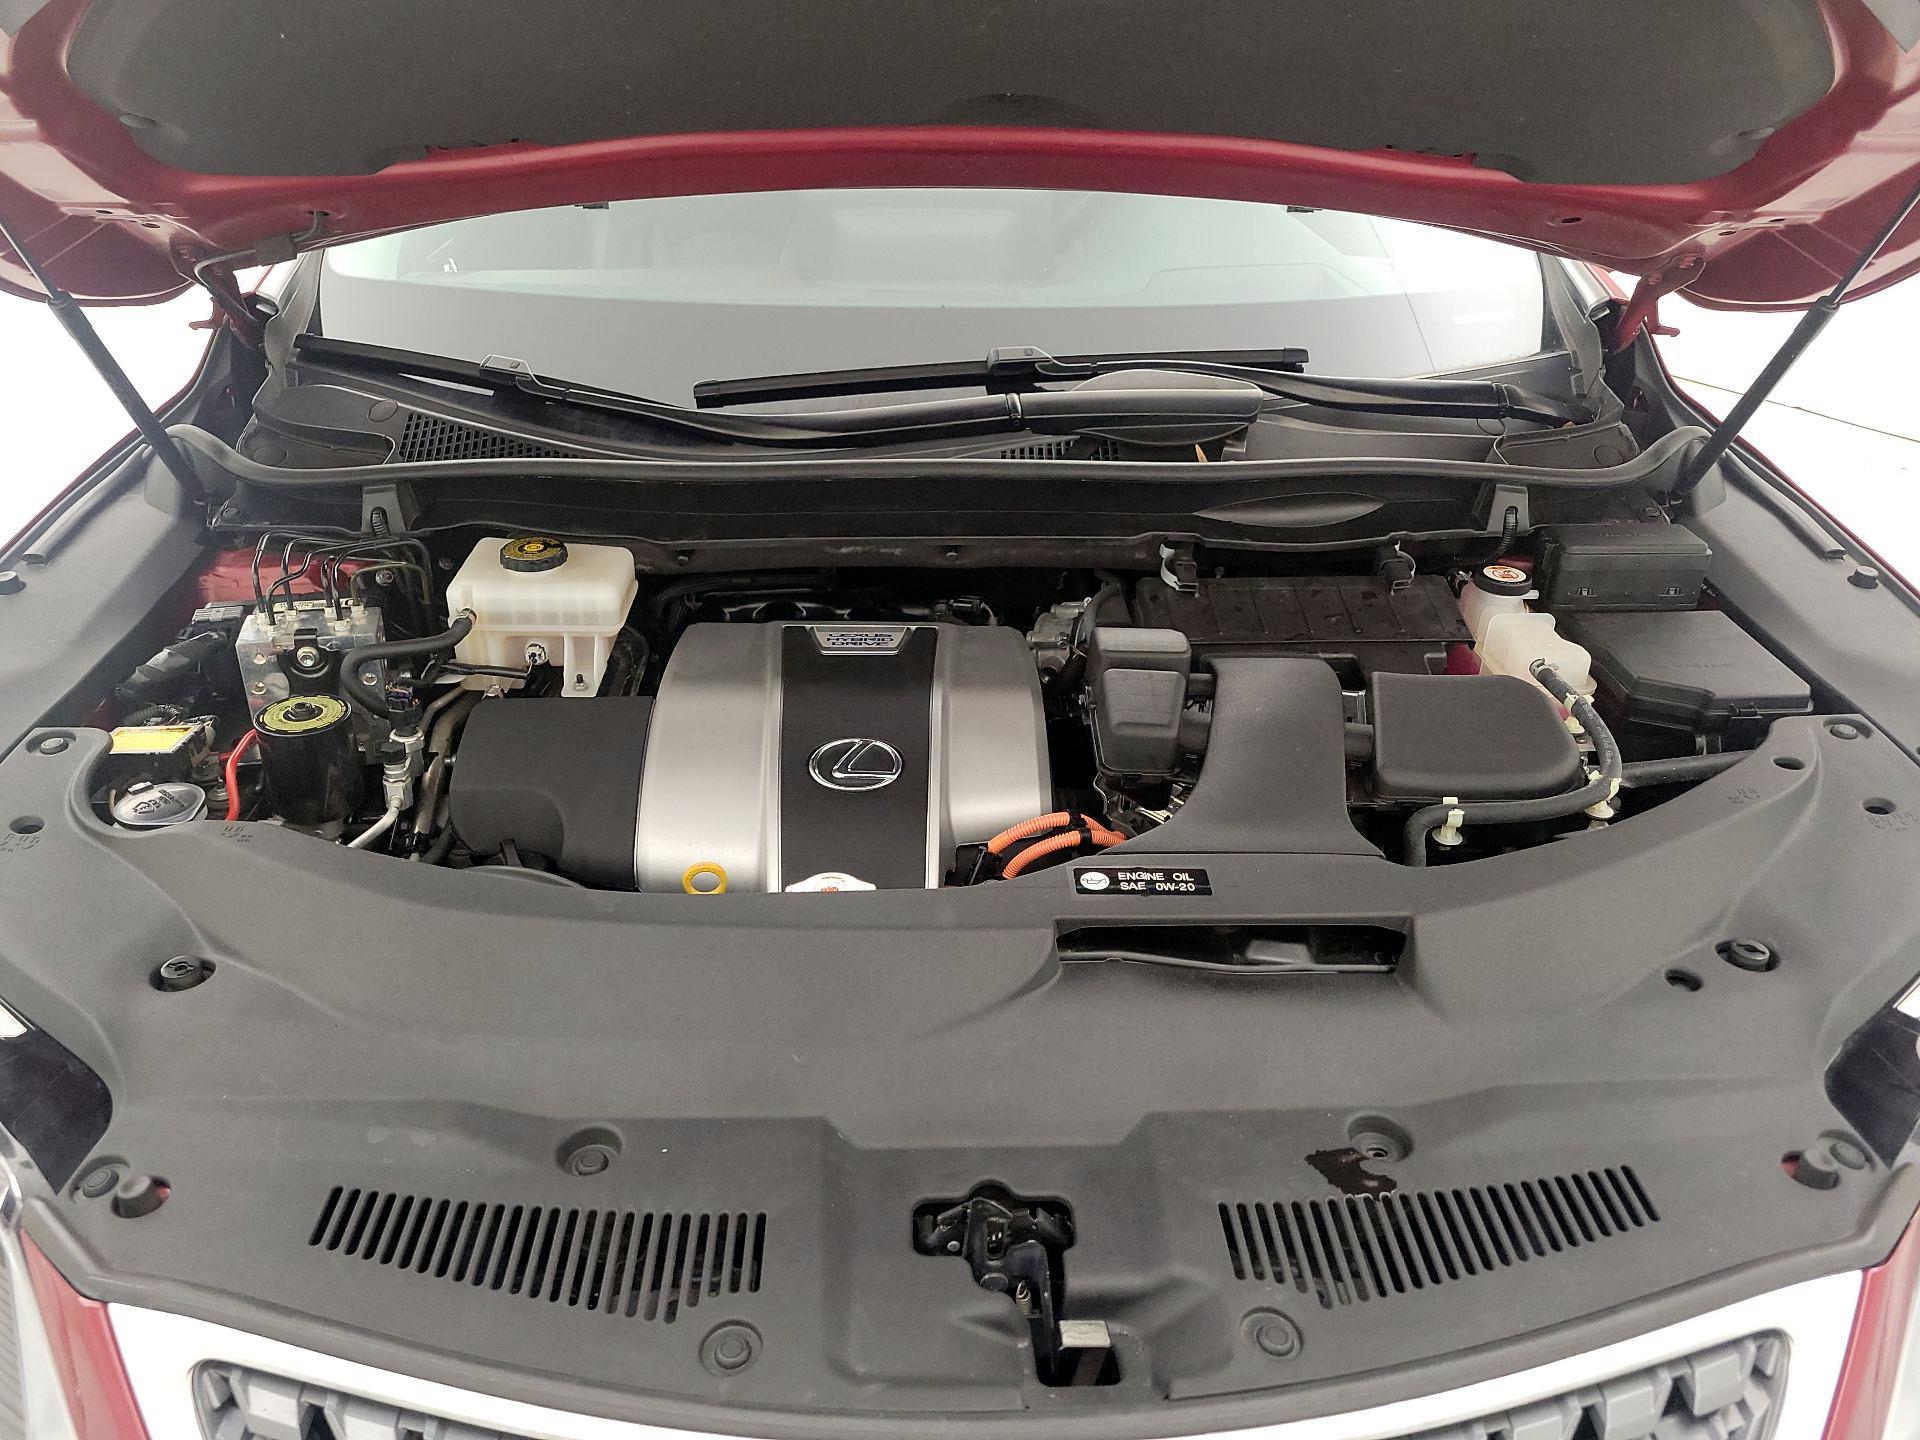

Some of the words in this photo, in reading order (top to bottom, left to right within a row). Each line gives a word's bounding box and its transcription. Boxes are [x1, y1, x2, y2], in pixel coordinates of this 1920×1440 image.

[1117, 871, 1165, 881] ENGINE
[1172, 872, 1195, 881] OIL
[1120, 881, 1147, 891] SAE
[1155, 882, 1196, 892] 0W-20
